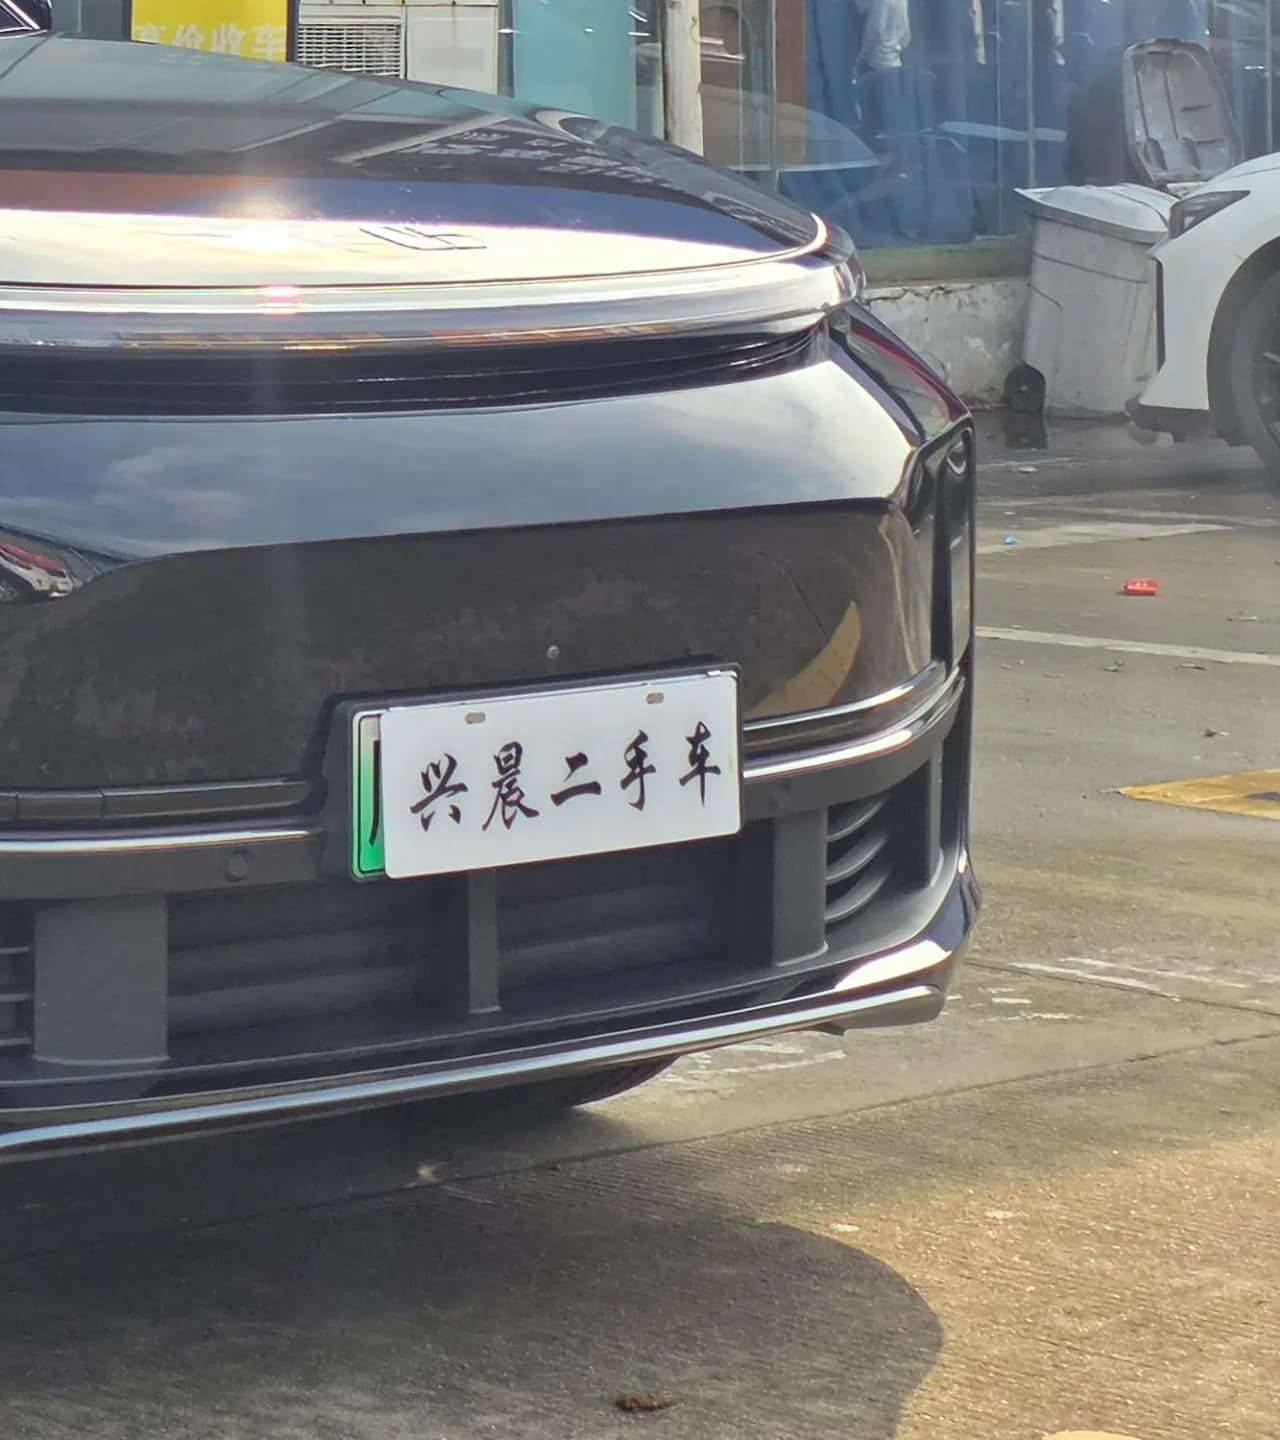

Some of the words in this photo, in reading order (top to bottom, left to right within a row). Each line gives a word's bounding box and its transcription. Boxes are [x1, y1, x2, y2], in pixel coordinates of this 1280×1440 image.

[410, 720, 721, 833] 兴晨二手车
